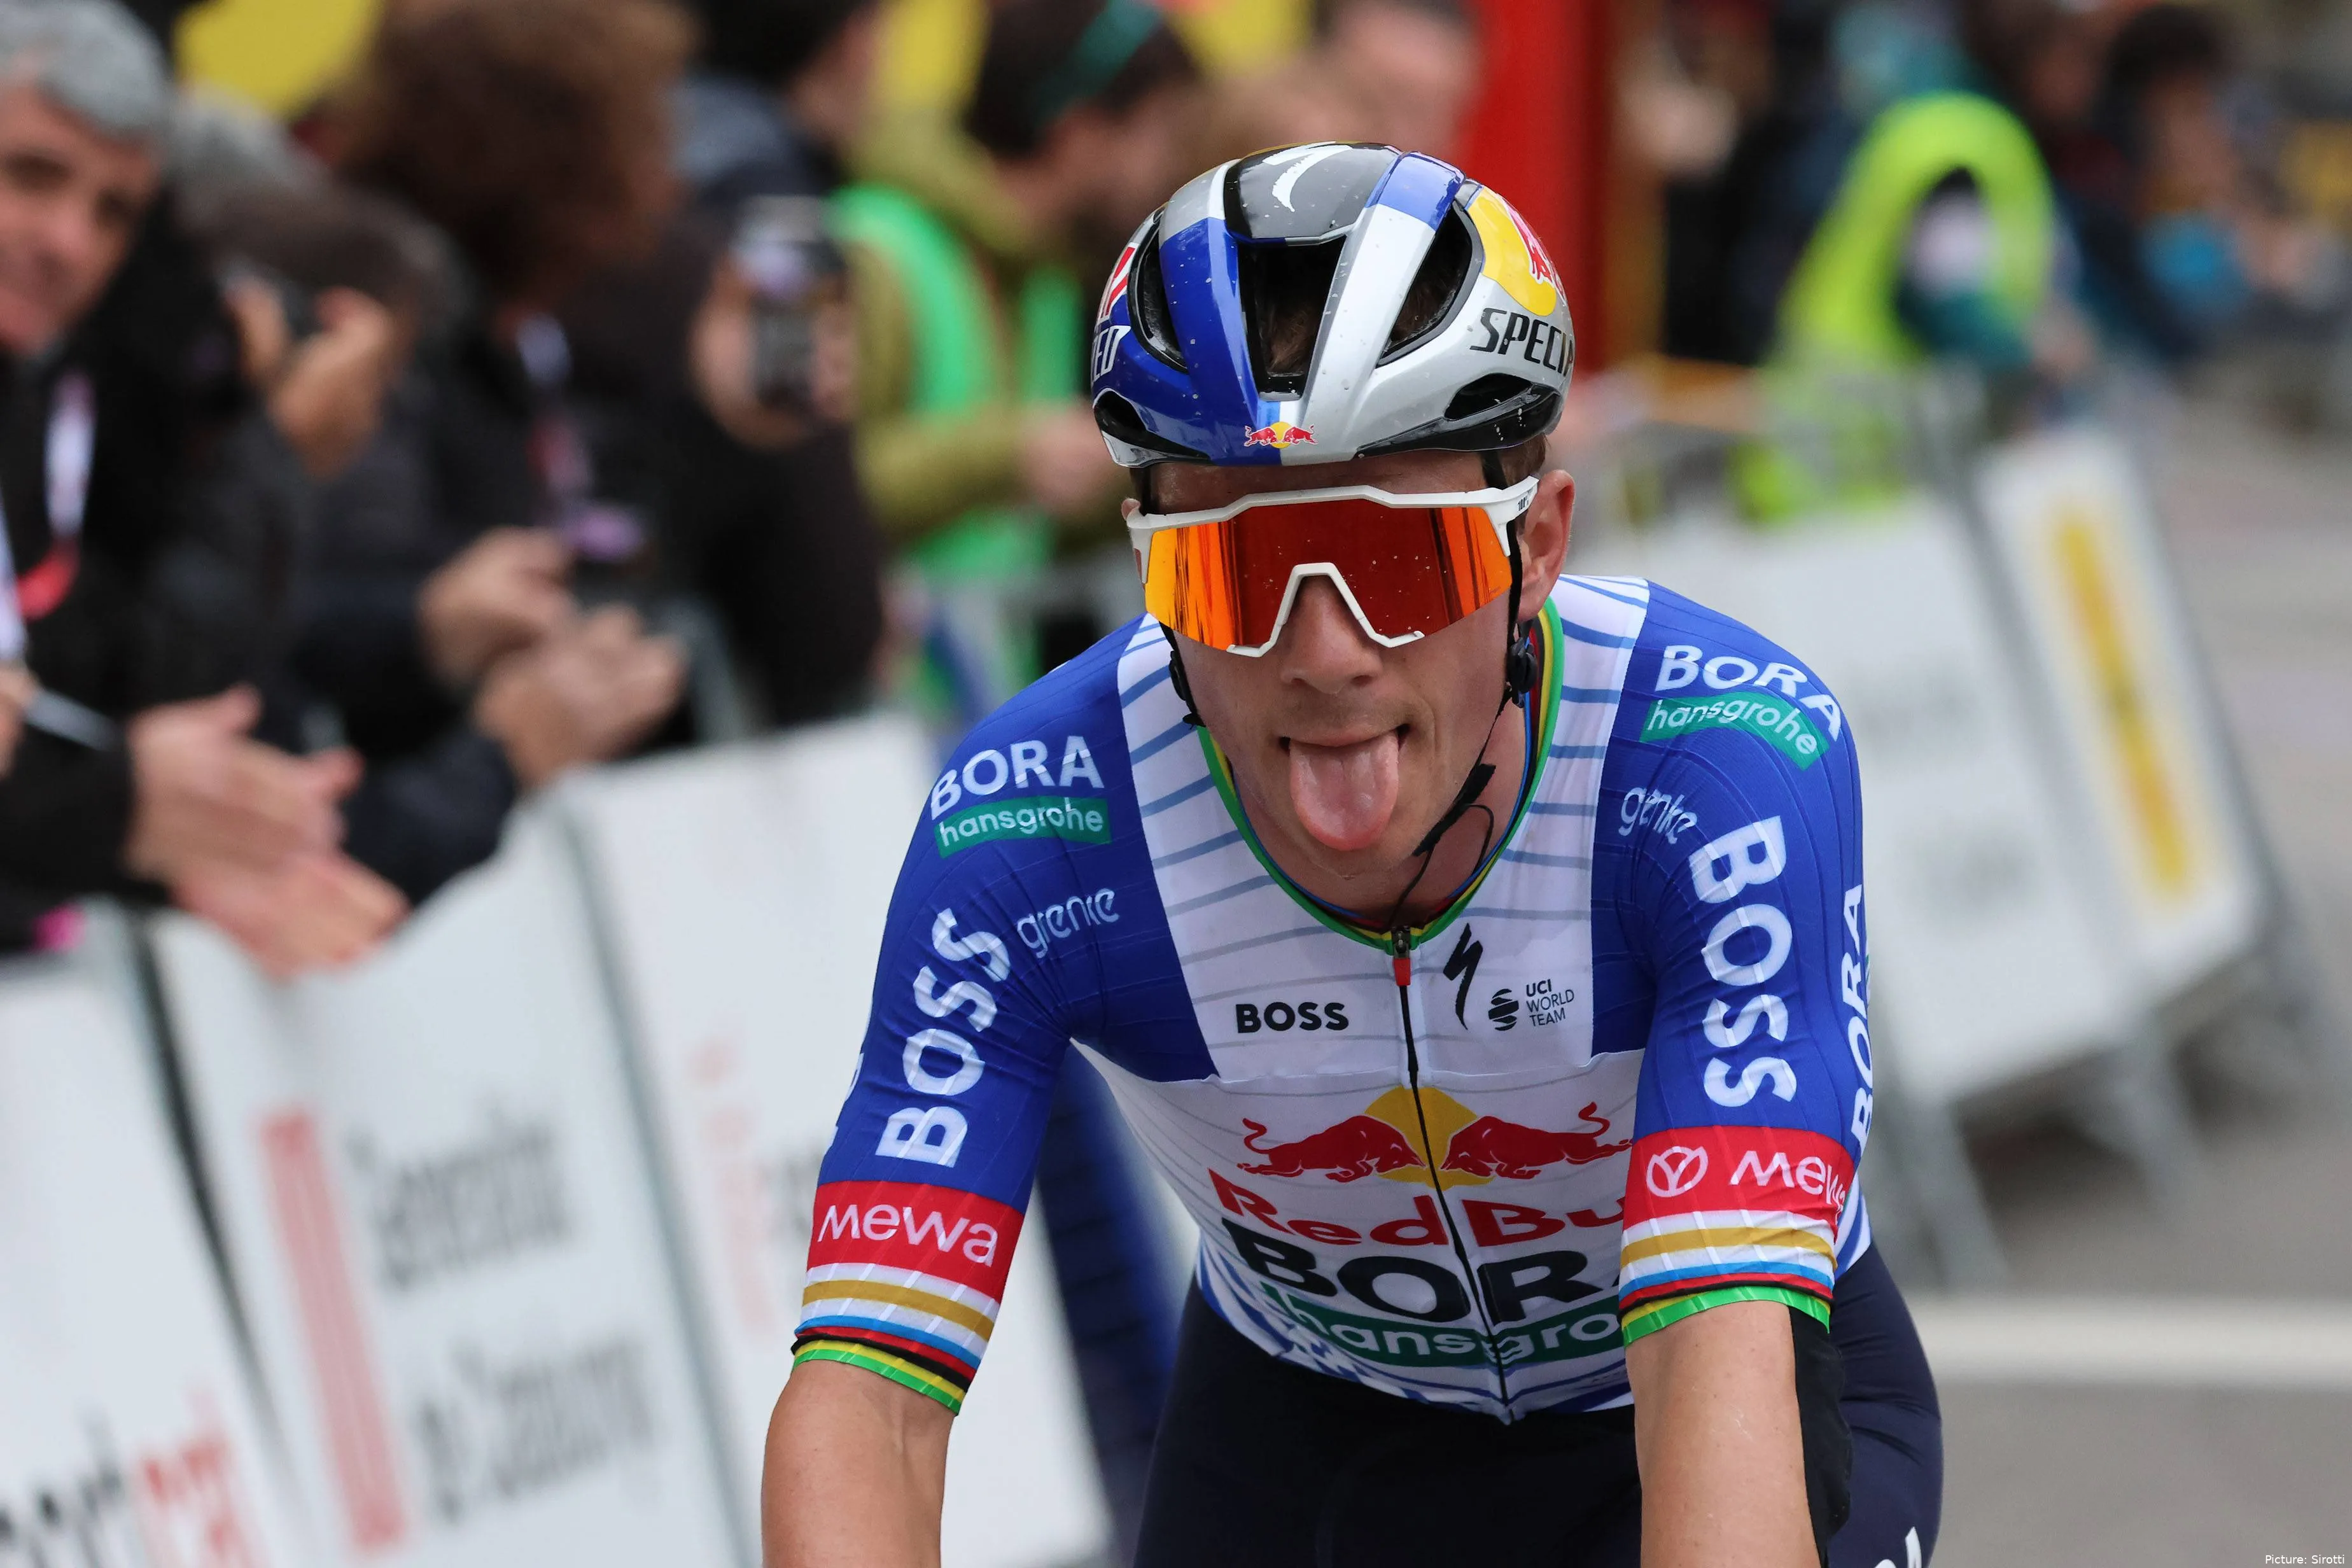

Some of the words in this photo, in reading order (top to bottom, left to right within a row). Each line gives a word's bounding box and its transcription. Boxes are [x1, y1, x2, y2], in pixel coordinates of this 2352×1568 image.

[1648, 699, 1818, 755] hansgrohe
[1655, 645, 1842, 743] BORA
[930, 735, 1105, 821] BORA
[939, 796, 1104, 847] hansgrohe
[1526, 979, 1552, 997] UCI
[1526, 989, 1575, 1012] WORLD
[1688, 815, 1798, 1108] BOSS
[874, 907, 1012, 1168] BOSS
[1235, 1001, 1350, 1034] BOSS
[1529, 1007, 1566, 1027] TEAM
[1841, 883, 1873, 1159] BORA
[1208, 1167, 1449, 1246] Red
[1462, 1196, 1625, 1248] Bu
[1222, 1217, 1620, 1326] BOR
[1278, 1281, 1620, 1365] hansgro
